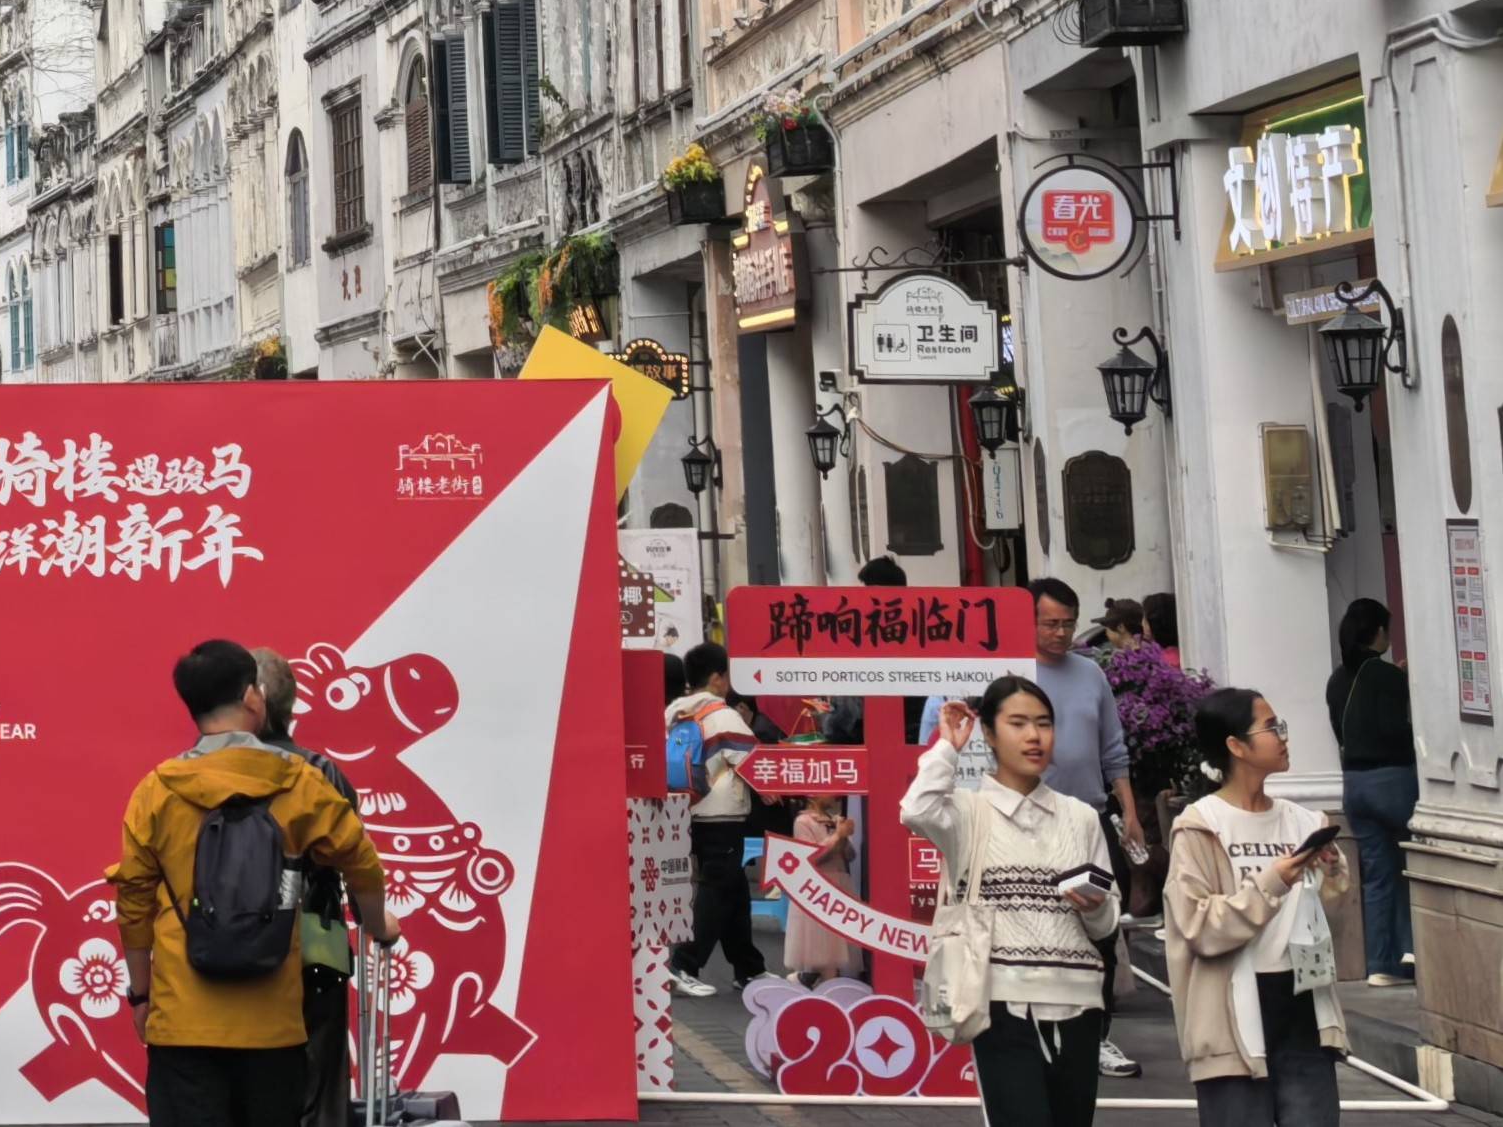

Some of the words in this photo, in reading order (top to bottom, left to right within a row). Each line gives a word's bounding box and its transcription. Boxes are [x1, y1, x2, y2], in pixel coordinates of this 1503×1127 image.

[1224, 125, 1361, 253] 文创特产
[1053, 195, 1102, 225] 春光
[917, 325, 978, 343] 卫生间
[917, 345, 971, 354] Restroom
[397, 475, 470, 496] 骑楼老街
[761, 593, 998, 655] 蹄响福临门
[776, 671, 817, 682] SOTTO
[822, 671, 885, 682] PORTICOS
[889, 671, 941, 682] STREETS
[947, 671, 993, 682] HAIKOU
[753, 758, 858, 784] 幸福加马
[917, 848, 940, 873] 马
[1228, 843, 1296, 857] CELINE
[799, 879, 875, 934] HAPPY
